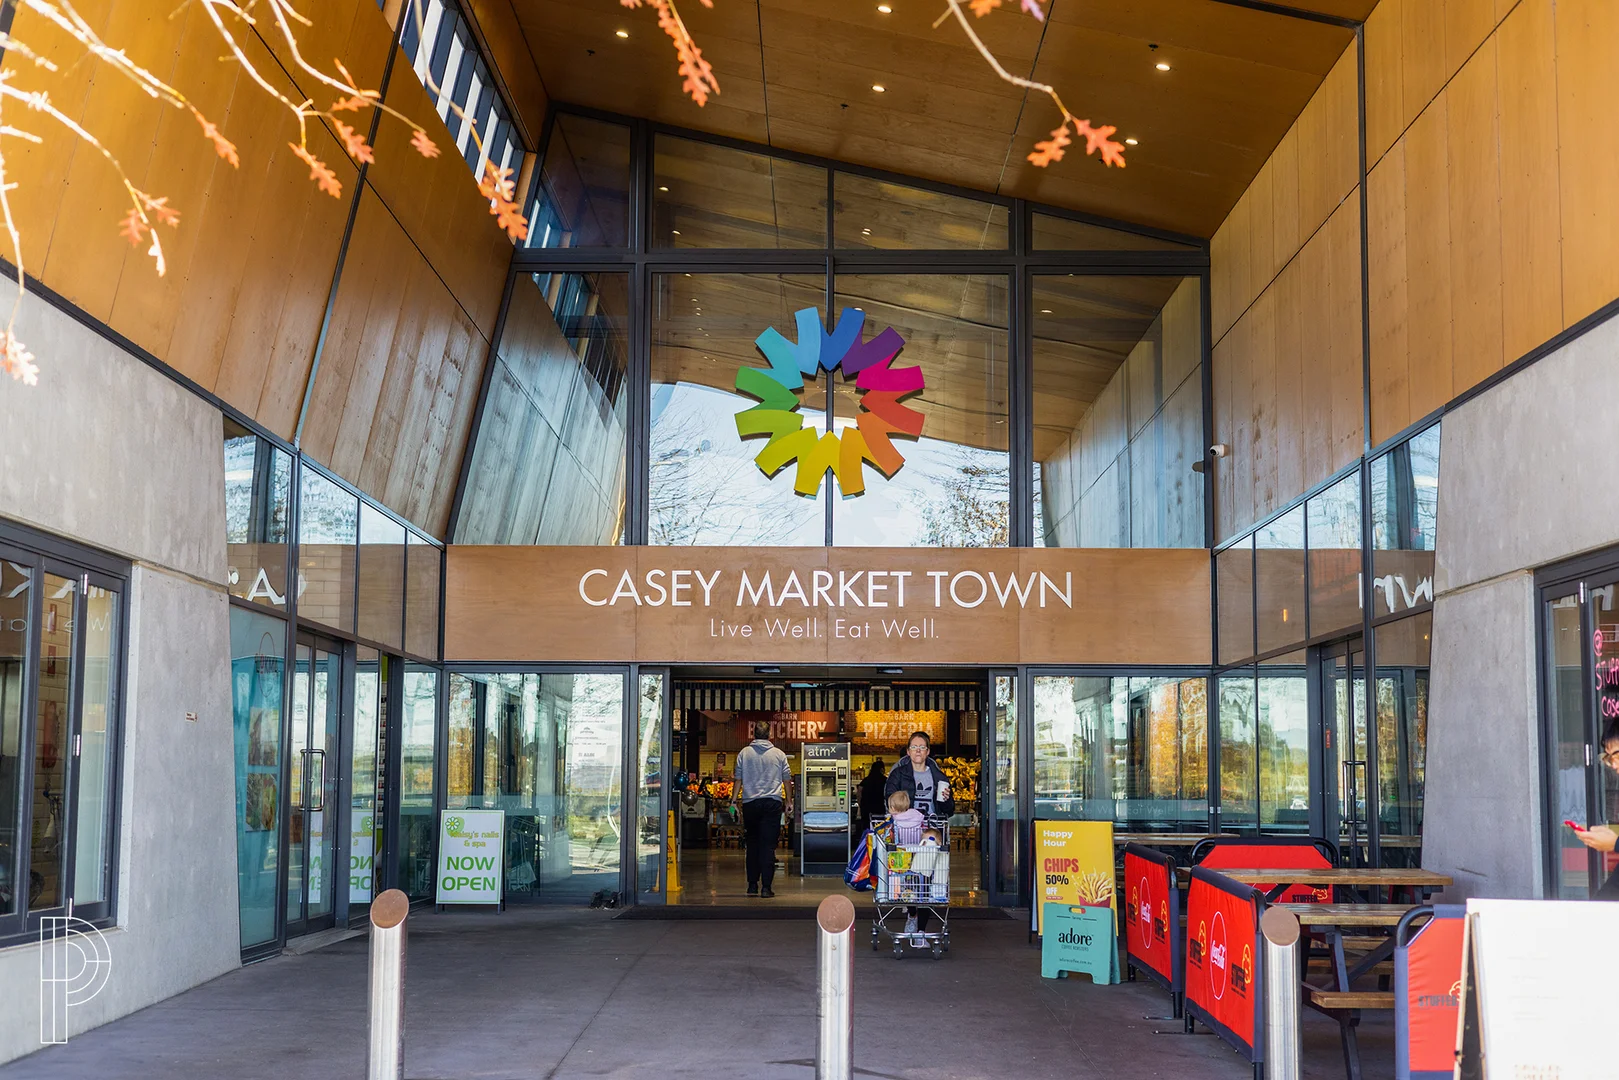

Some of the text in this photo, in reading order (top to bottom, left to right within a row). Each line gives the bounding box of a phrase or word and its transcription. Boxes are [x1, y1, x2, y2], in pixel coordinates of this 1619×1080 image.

[578, 568, 1073, 609] CASEY MARKET TOWN
[710, 618, 939, 639] Live Well. Eat Well.
[748, 721, 827, 739] BTCHERY
[1043, 829, 1073, 839] Happy
[472, 841, 486, 849] spa
[1043, 839, 1066, 847] Hour
[446, 856, 495, 871] NOW
[1044, 857, 1079, 873] CHIPS
[441, 876, 496, 891] OPEN
[1045, 874, 1069, 885] 50%
[1045, 886, 1058, 895] OFF
[1058, 927, 1092, 946] adore
